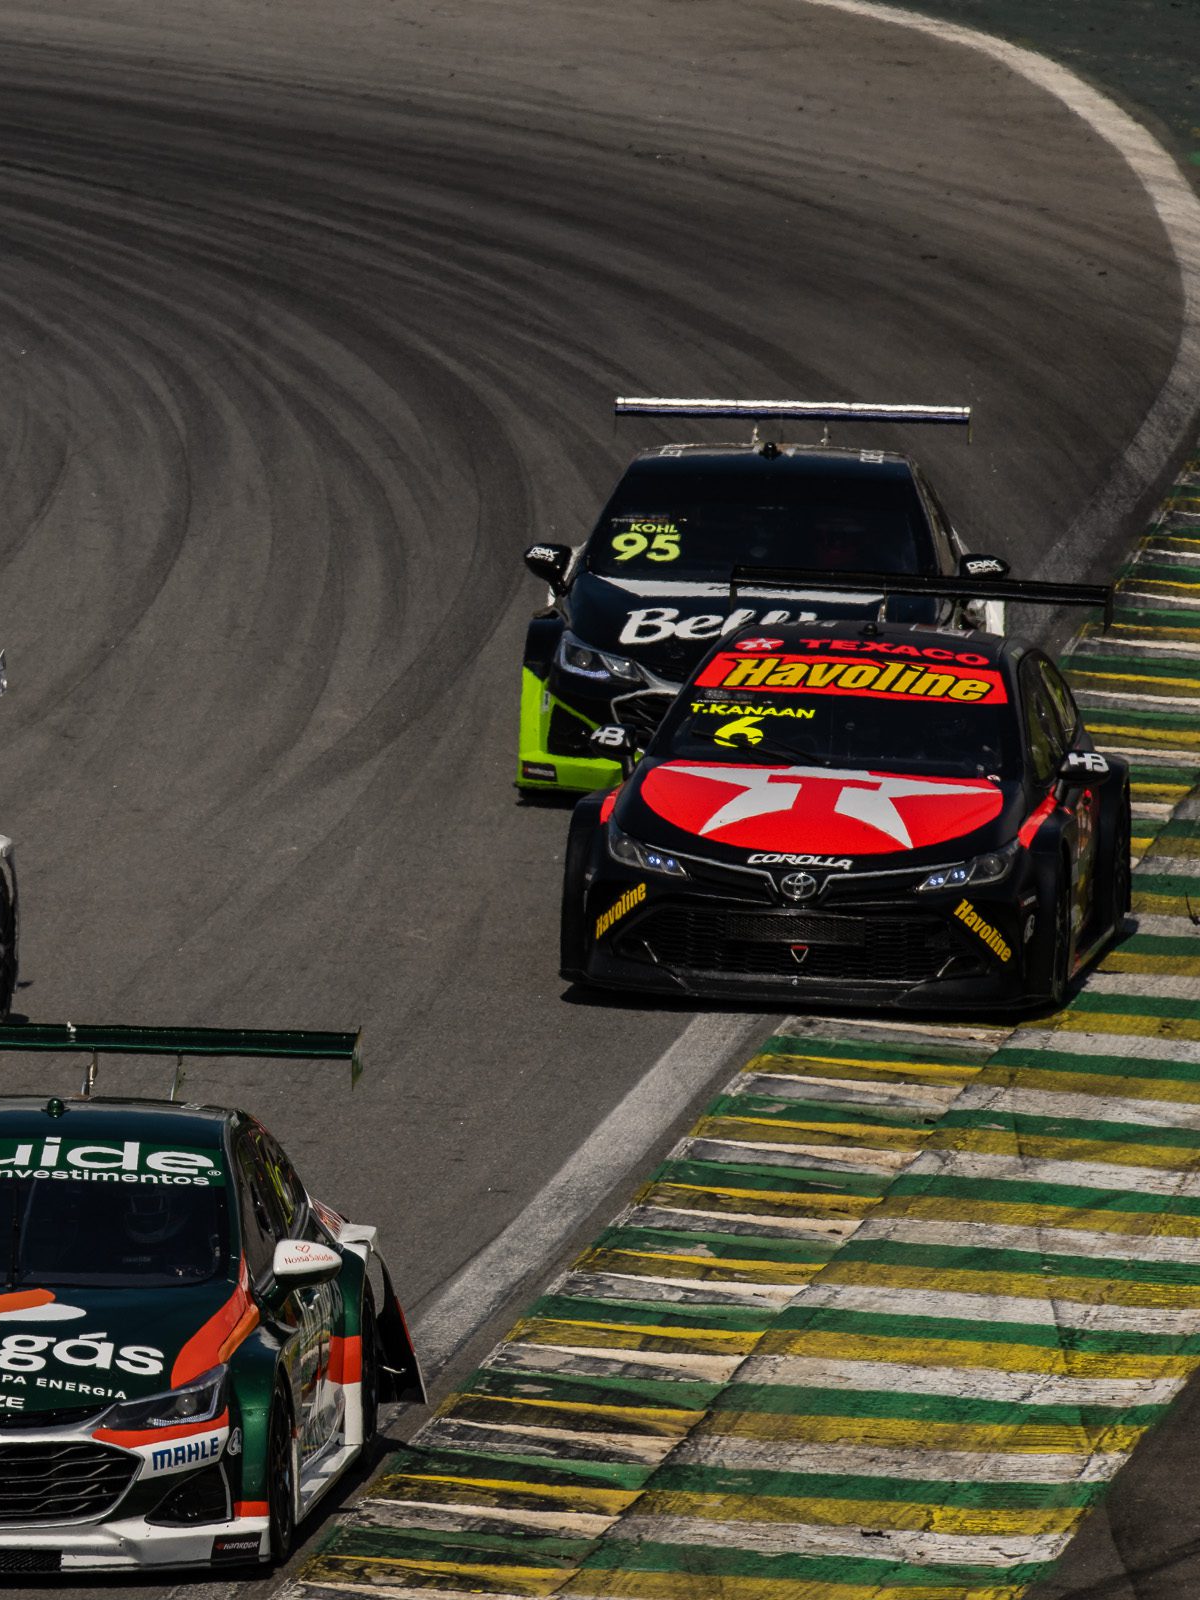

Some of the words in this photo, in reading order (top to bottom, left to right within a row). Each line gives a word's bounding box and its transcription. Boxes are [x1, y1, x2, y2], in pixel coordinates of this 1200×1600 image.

[630, 523, 678, 533] KOHL
[611, 532, 682, 562] 95
[800, 638, 990, 666] TEXACO
[722, 657, 991, 700] Havoline
[691, 703, 816, 719] T.KANAAN
[714, 716, 764, 747] 6
[747, 853, 853, 871] COROLLA
[595, 882, 647, 940] Havoline
[953, 898, 1012, 962] Havoline
[35, 1377, 127, 1400] ENERGIA
[151, 1437, 219, 1471] MAHLE
